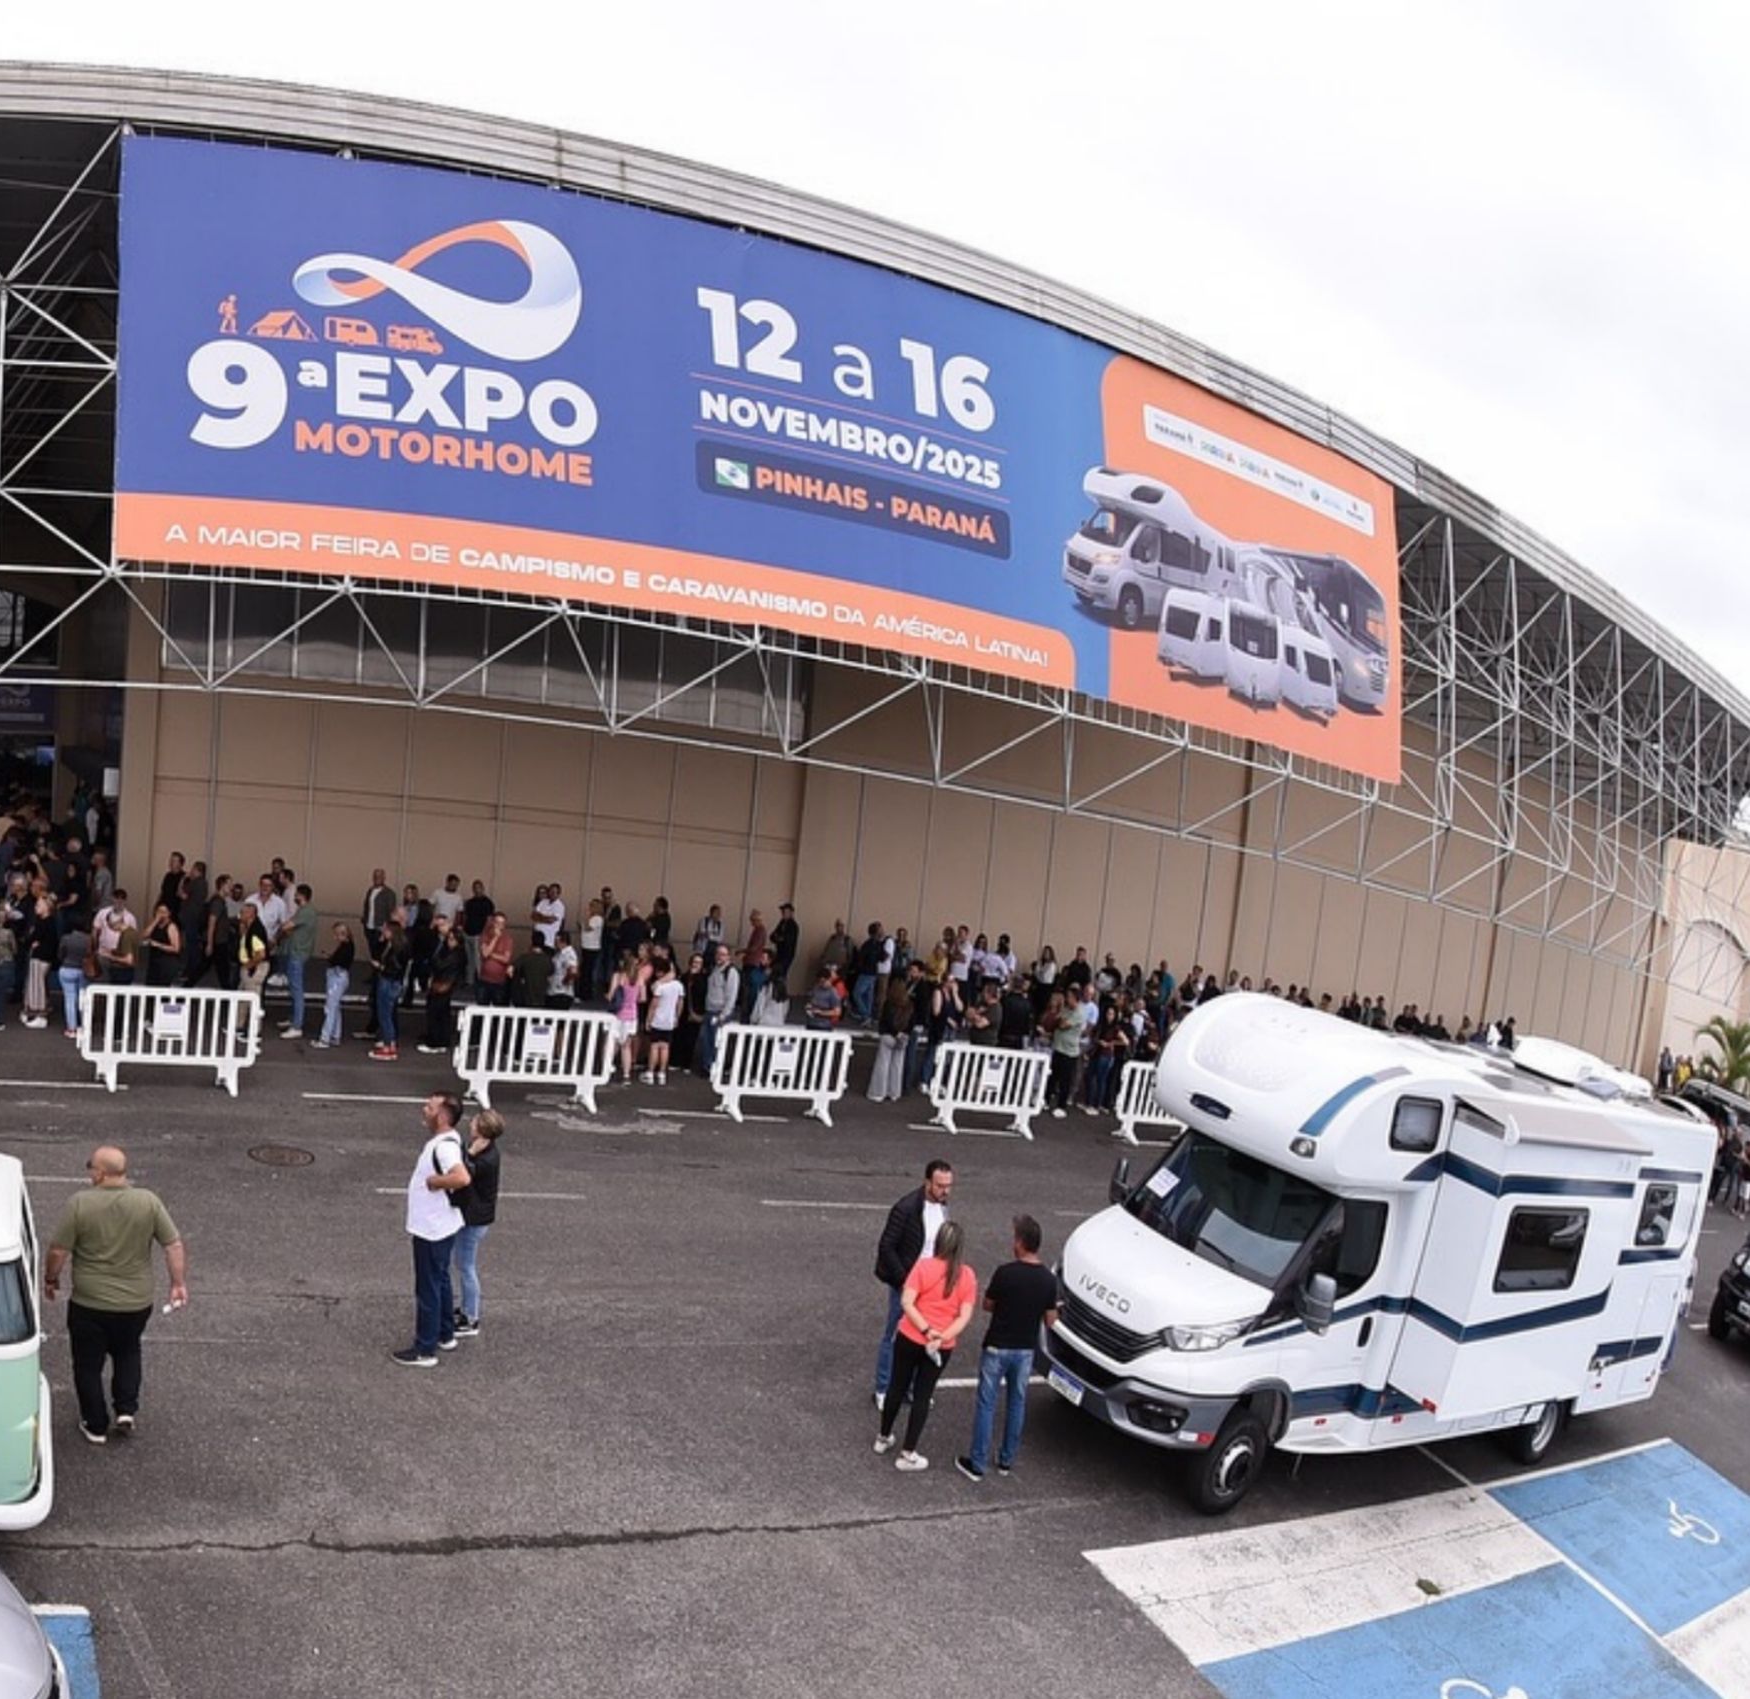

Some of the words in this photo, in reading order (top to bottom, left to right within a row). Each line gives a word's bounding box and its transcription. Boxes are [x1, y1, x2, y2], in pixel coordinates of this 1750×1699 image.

[336, 351, 598, 447] EXPO
[697, 287, 802, 382] 12
[832, 344, 874, 400] a
[900, 338, 996, 432] 16
[294, 420, 593, 486] MOTORHOME
[700, 389, 1001, 489] NOVEMBRO/2025
[755, 466, 869, 511] PINHAIS
[891, 495, 997, 543] PARANÁ
[165, 524, 188, 543] A
[198, 525, 301, 551] MAIOR
[311, 534, 401, 559] FEIRA
[410, 543, 451, 564] DE
[459, 548, 616, 586] CAMPISMO
[623, 571, 641, 590] E
[648, 573, 828, 619] CARAVANISMO
[833, 608, 866, 626] DA
[873, 613, 969, 648] AMÉRICA
[974, 636, 1049, 668] LATINA!
[1078, 1273, 1132, 1314] IVECO
